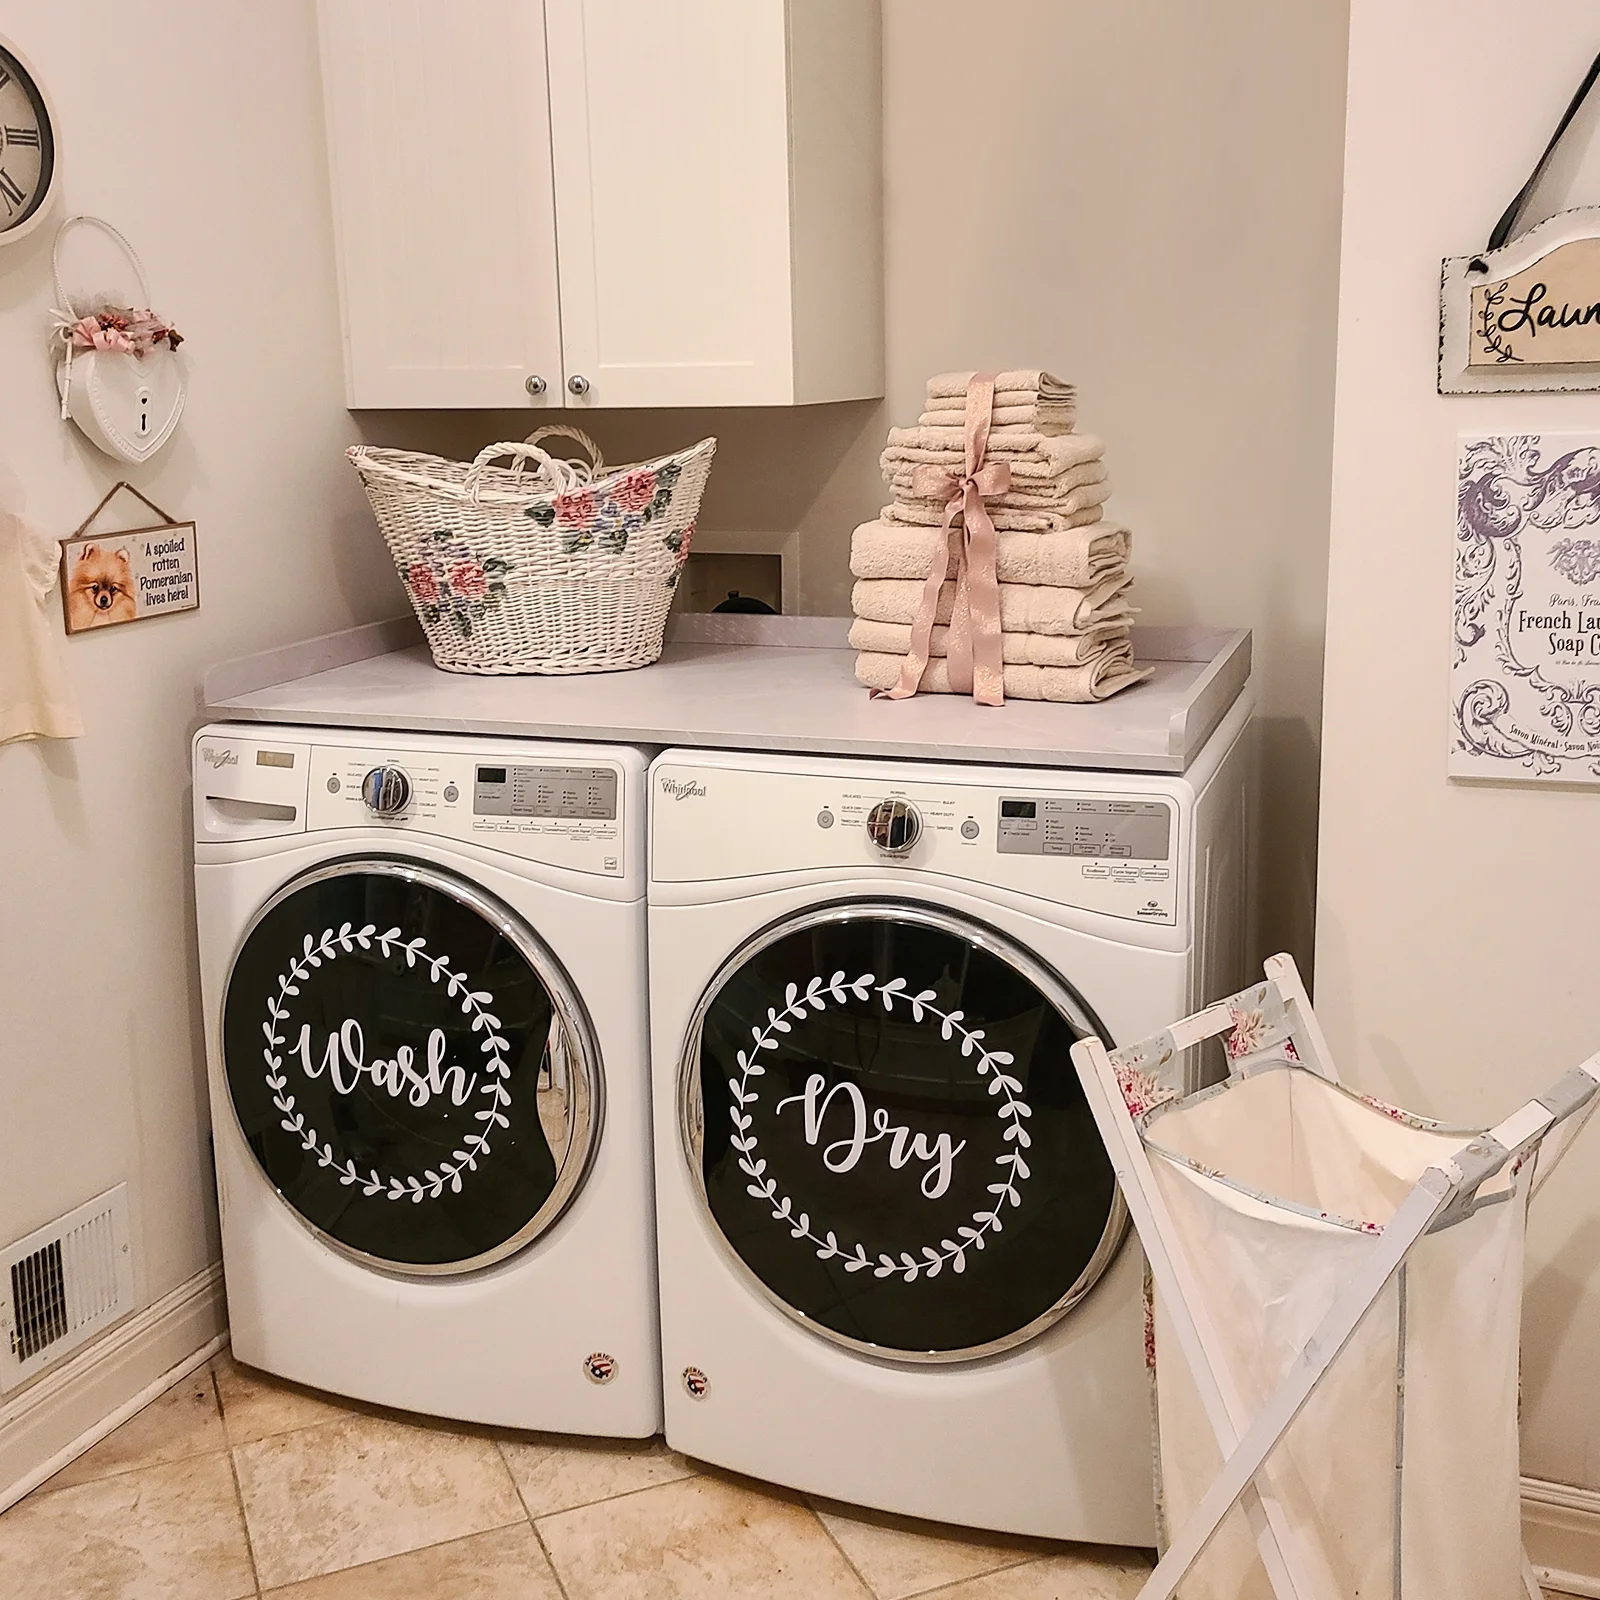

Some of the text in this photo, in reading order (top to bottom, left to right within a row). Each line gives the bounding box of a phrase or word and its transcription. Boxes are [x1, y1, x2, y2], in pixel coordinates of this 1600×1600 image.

[145, 538, 184, 557] A spoiled
[152, 558, 180, 572] rotten
[140, 572, 193, 591] Pomeranian
[146, 586, 189, 606] lives here!
[1548, 593, 1578, 607] Paris,
[1519, 610, 1571, 632] French
[1548, 632, 1584, 656] Soap
[1509, 724, 1530, 740] Savon
[1564, 741, 1585, 752] Savon
[661, 778, 706, 800] Whirlpool
[288, 1018, 478, 1107] Wash
[776, 1074, 966, 1199] Dry
